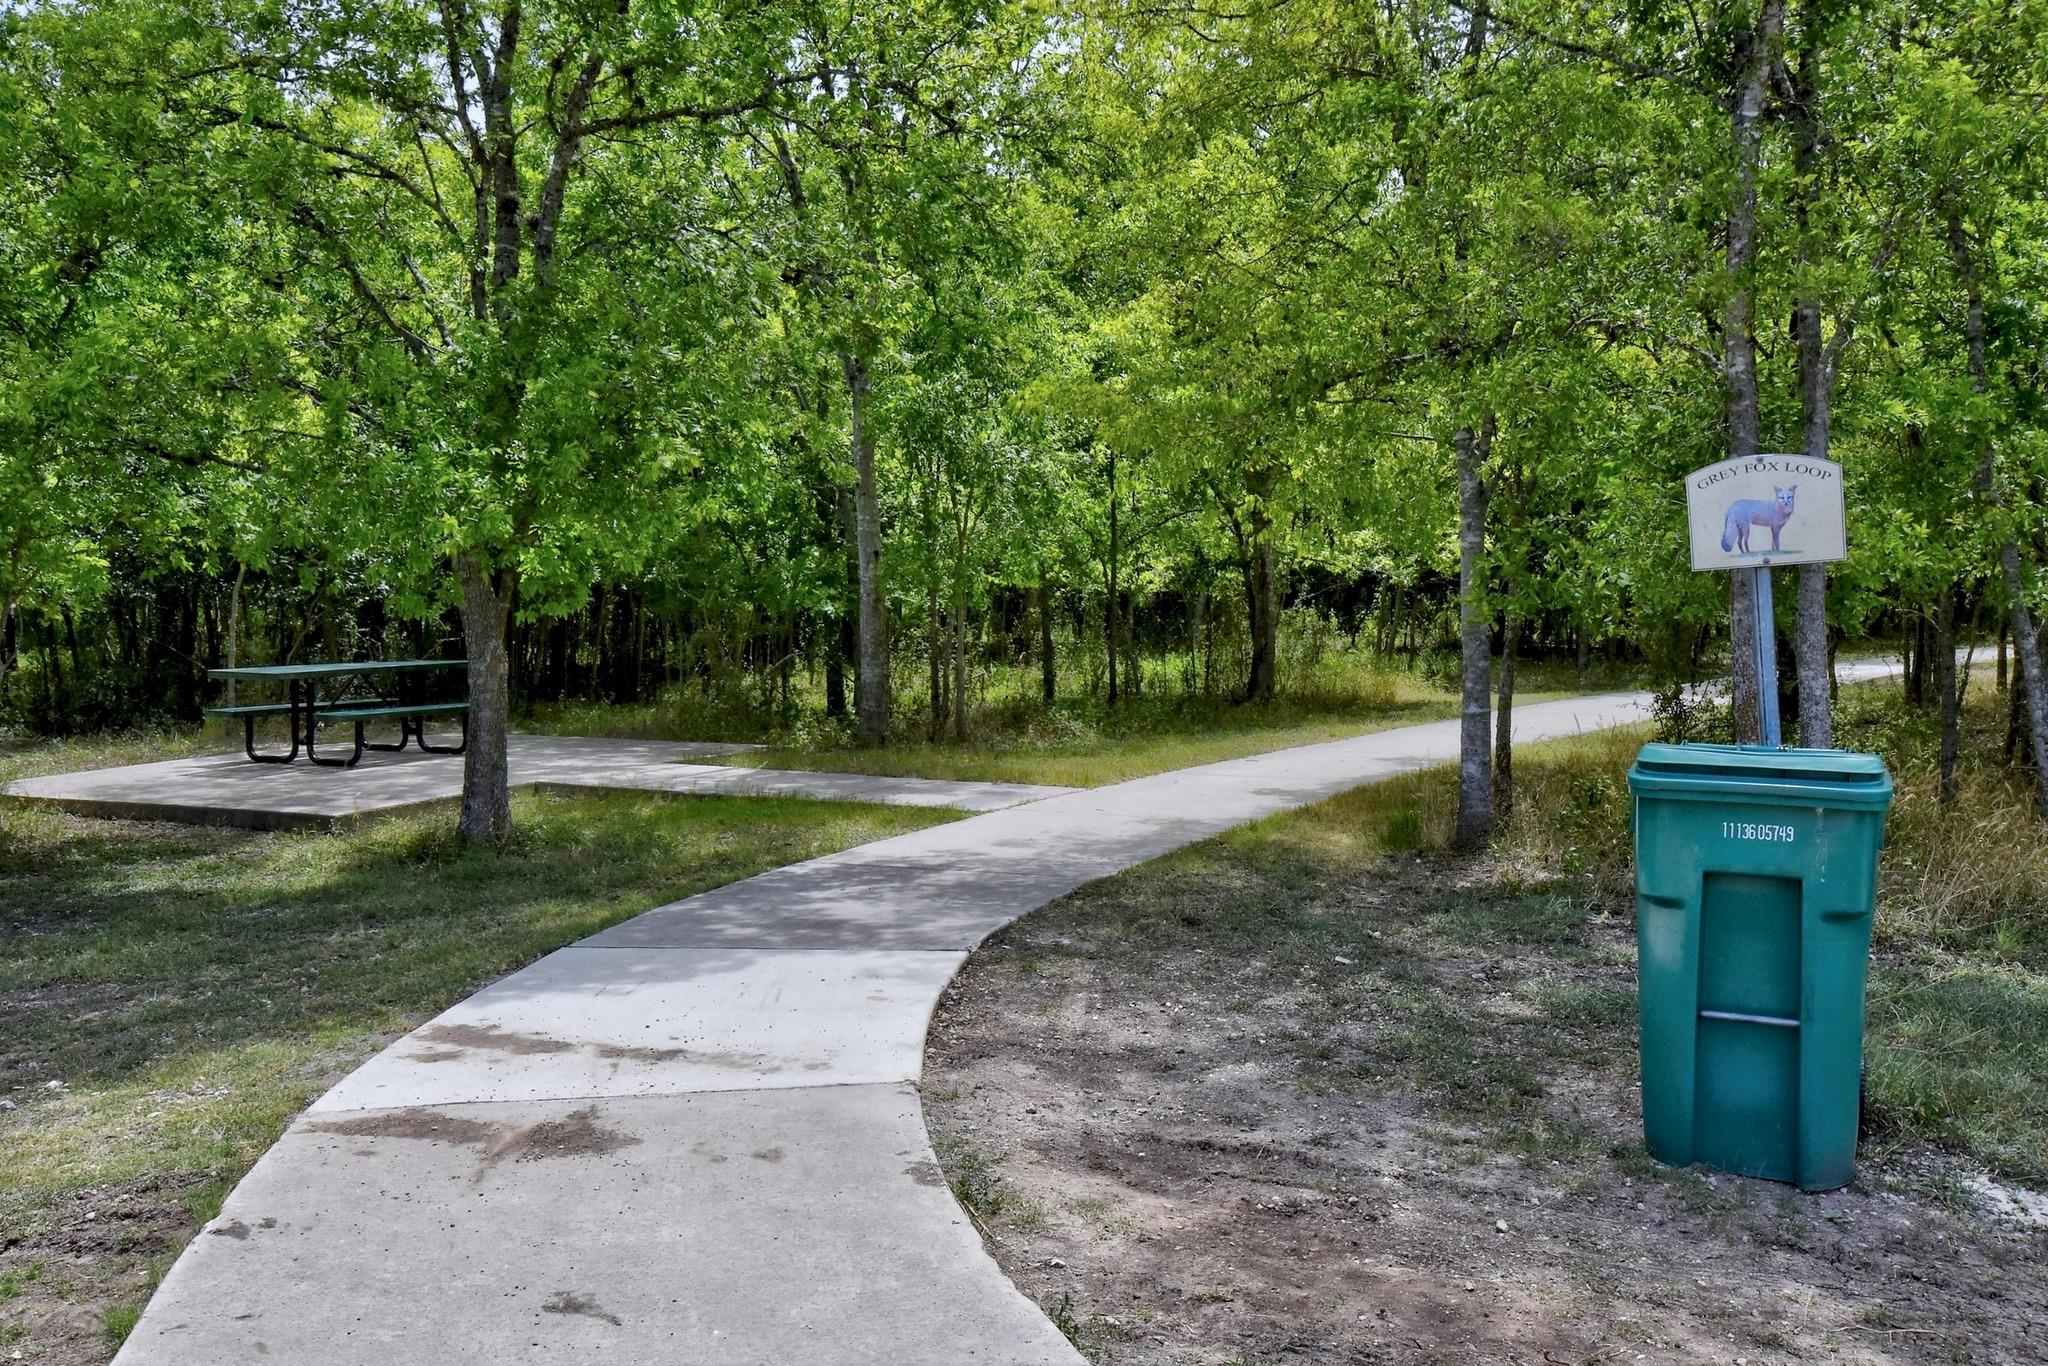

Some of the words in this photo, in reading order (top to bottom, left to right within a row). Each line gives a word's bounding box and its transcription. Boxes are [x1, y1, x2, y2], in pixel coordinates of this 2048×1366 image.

[1697, 465, 1740, 490] GREY
[1744, 461, 1779, 474] FOX
[1785, 462, 1832, 481] LOOP
